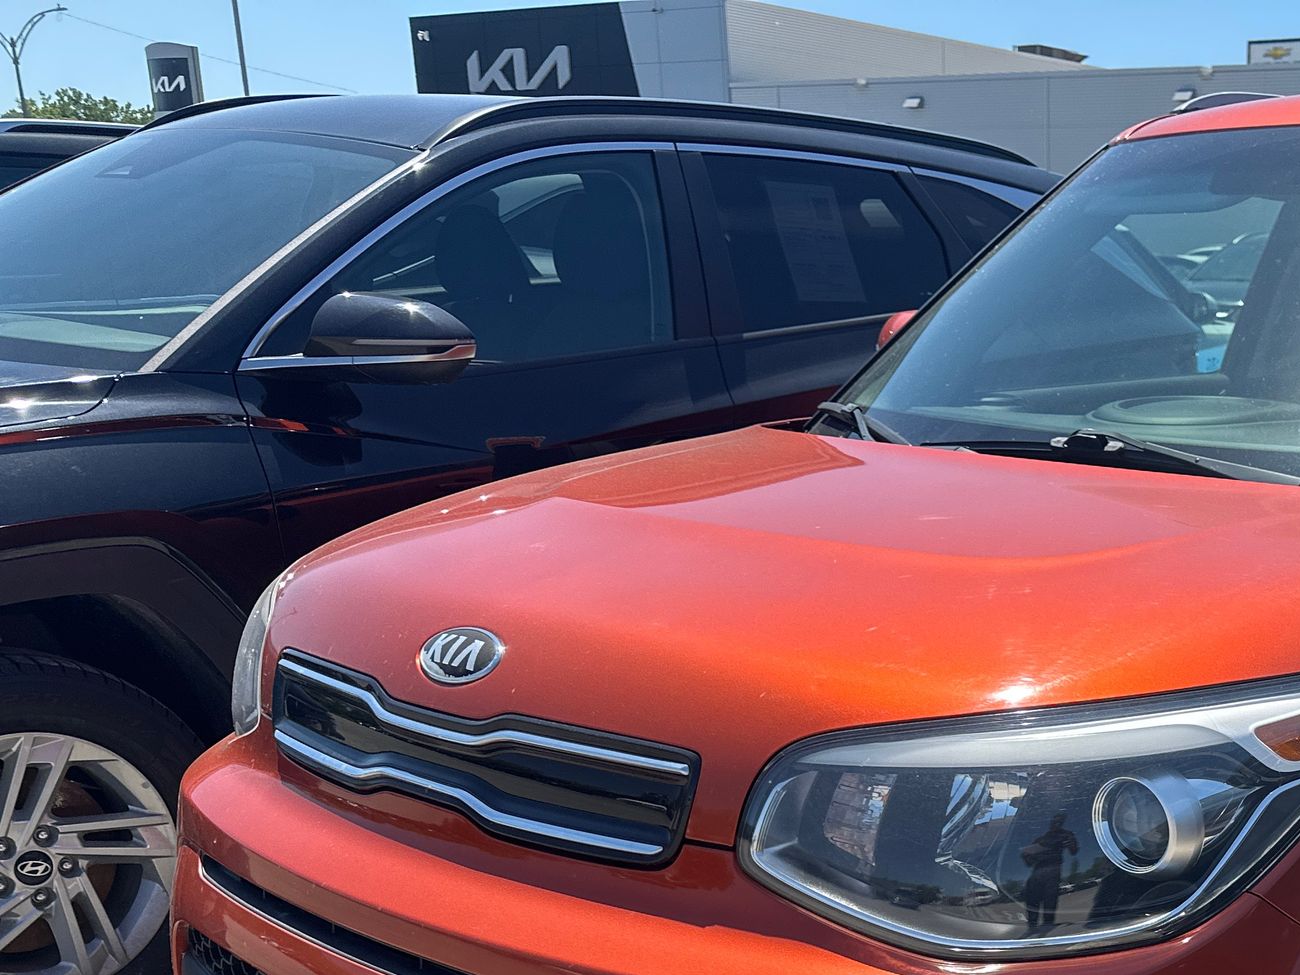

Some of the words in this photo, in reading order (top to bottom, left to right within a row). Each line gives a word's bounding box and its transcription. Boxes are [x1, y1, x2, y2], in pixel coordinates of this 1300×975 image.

[152, 75, 186, 93] KIA
[466, 45, 572, 94] KIA
[425, 633, 485, 672] KIA
